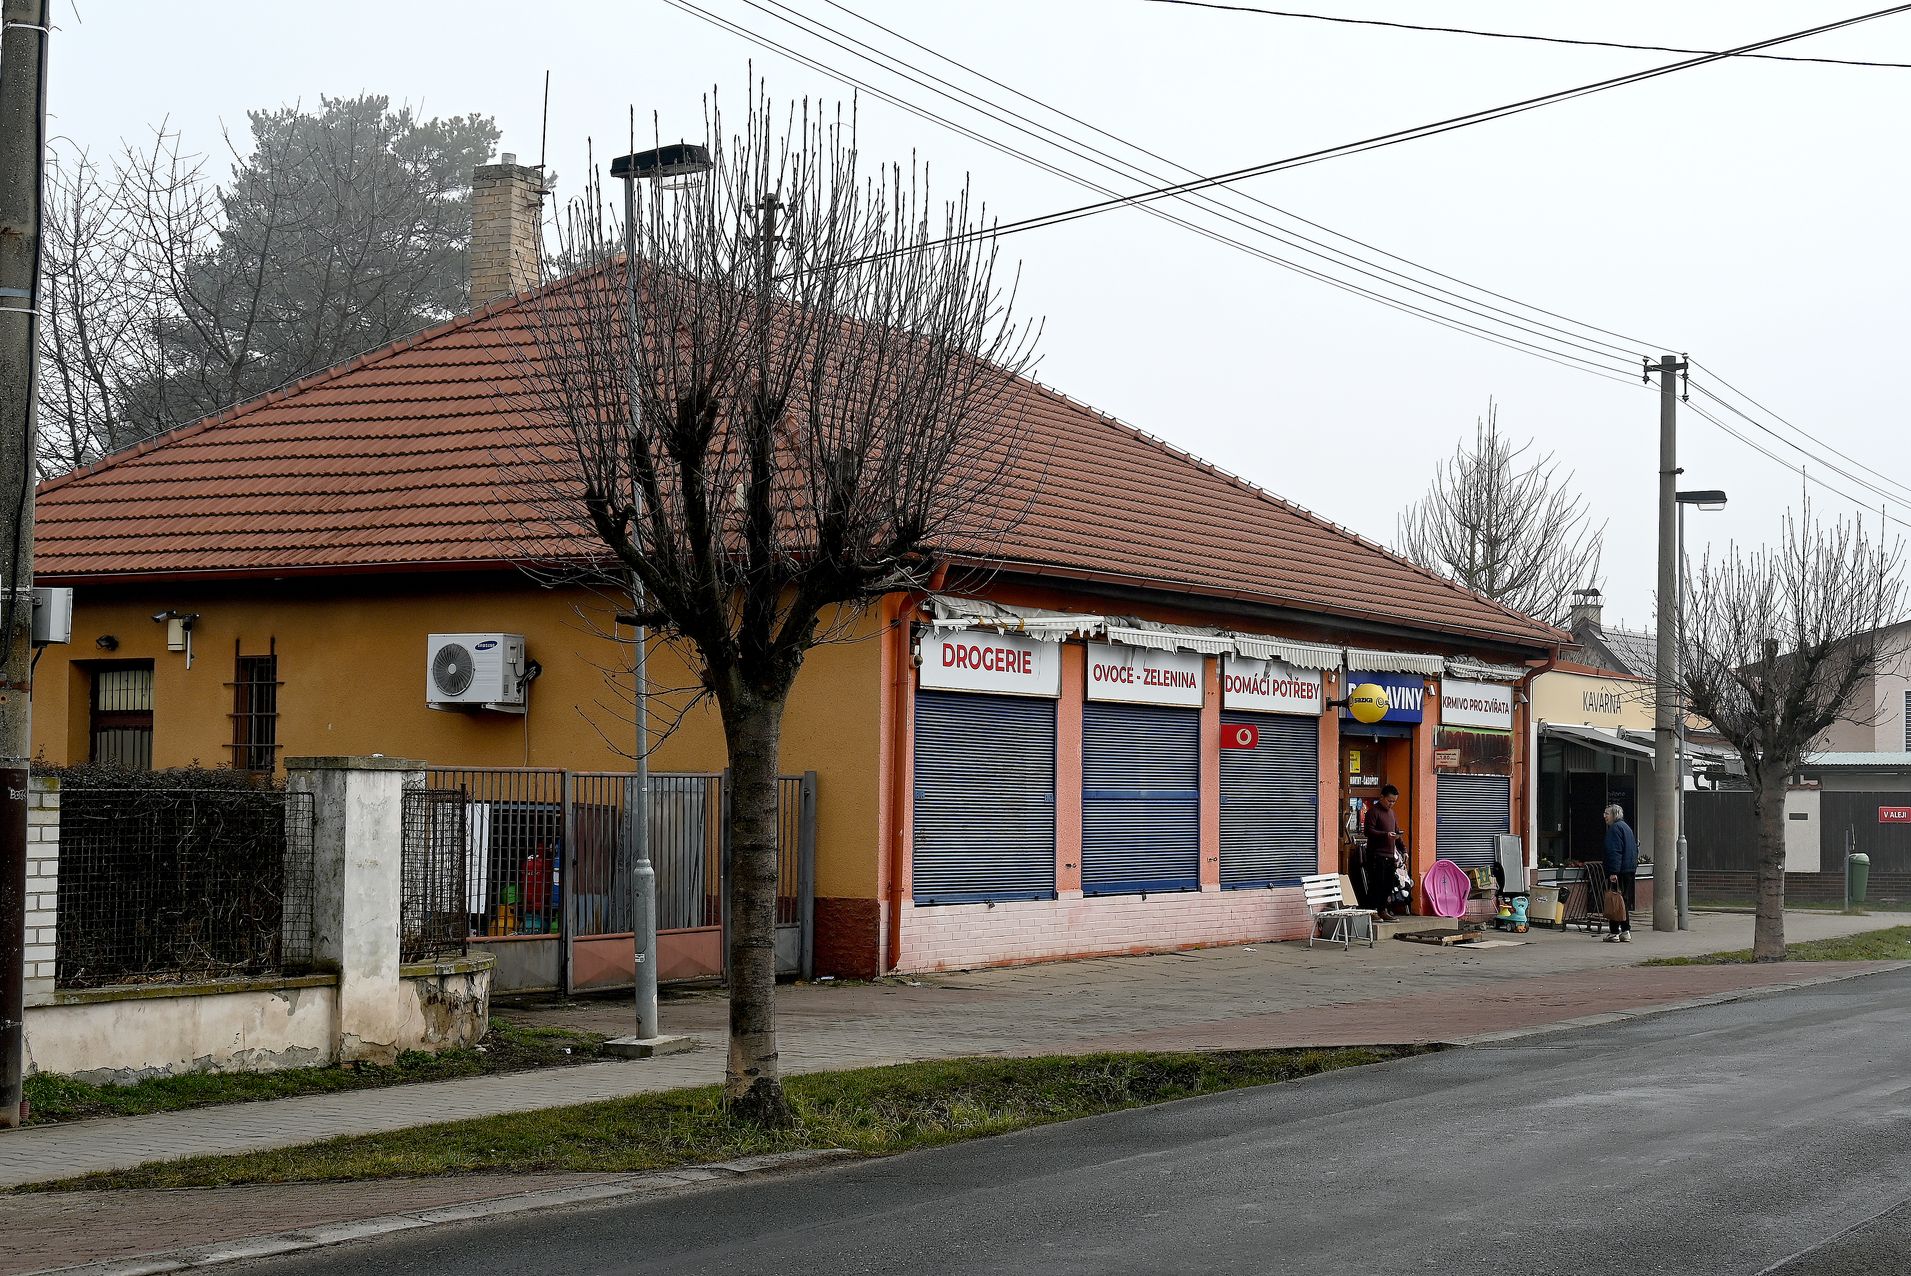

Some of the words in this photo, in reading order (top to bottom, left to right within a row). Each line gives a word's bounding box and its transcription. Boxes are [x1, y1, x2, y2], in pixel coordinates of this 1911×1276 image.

[942, 642, 1032, 675] DROGERIE
[1093, 663, 1134, 684] OVOCE
[1143, 668, 1197, 689] ZELENINA
[1225, 673, 1270, 696] DOMÁCÍ
[1272, 677, 1320, 700] POTŘEBY
[1442, 695, 1469, 710] KRMIVO
[1469, 698, 1483, 712] PRO
[1484, 698, 1510, 714] ZVÍŘATA
[1582, 686, 1622, 715] KAVÁRNA
[1890, 811, 1907, 819] ALEJI
